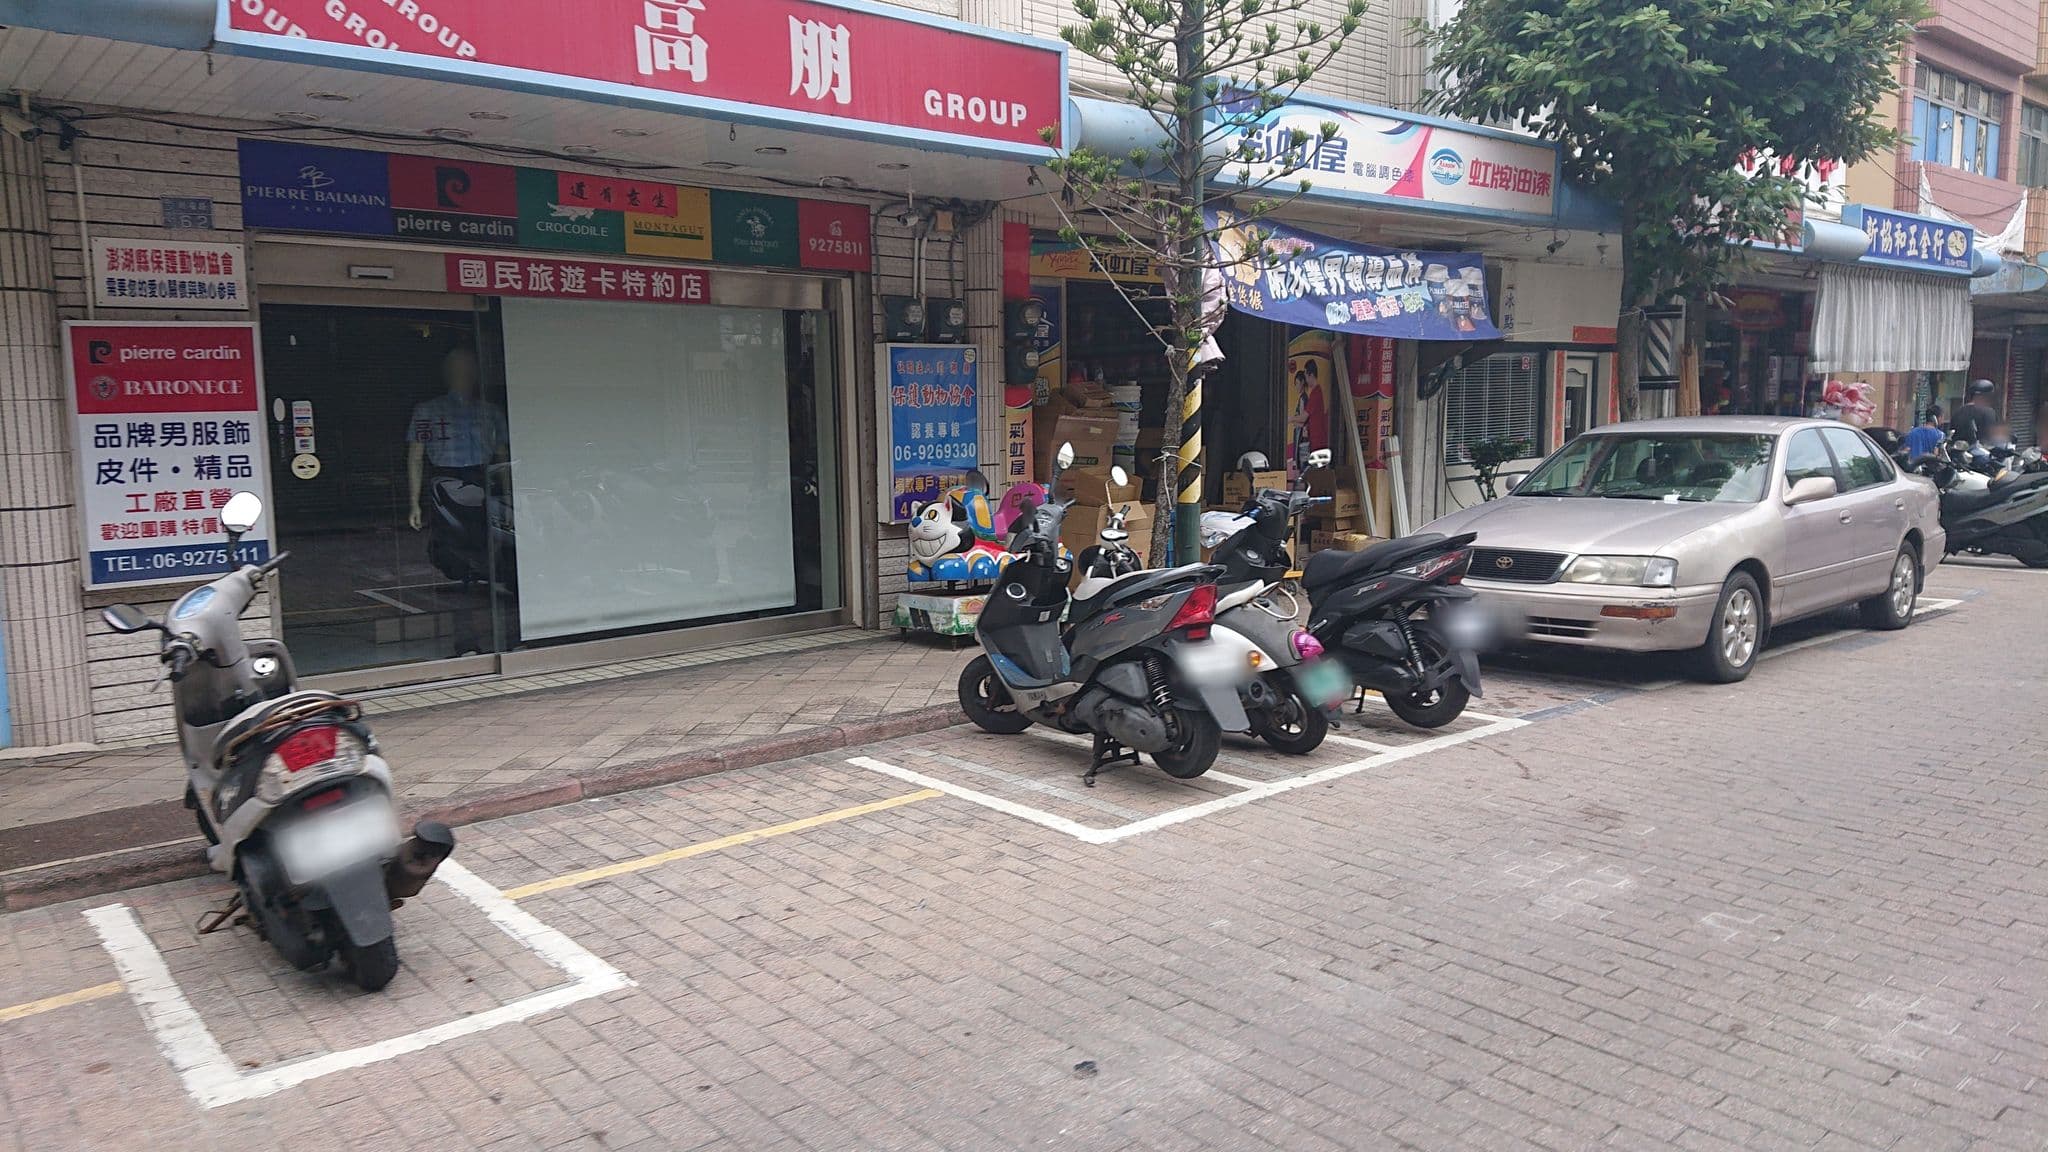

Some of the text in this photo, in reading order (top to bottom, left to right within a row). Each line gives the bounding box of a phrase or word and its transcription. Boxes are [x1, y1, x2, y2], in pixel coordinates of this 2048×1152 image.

[634, 0, 851, 104] 高朋
[924, 89, 1027, 128] GROUP
[1352, 161, 1414, 184] 電腦調色漆
[1468, 157, 1552, 197] 虹牌油漆
[247, 185, 386, 206] PIERRE BALMAIN
[397, 216, 514, 236] pierre cardin
[536, 221, 608, 237] CROCODILE
[633, 220, 705, 236] MONTAGUT
[809, 238, 863, 256] 9275811
[1866, 215, 1945, 261] 新協和五金行
[106, 247, 233, 275] 澎湖縣保護動物協會
[458, 258, 702, 300] 國民旅遊卡特約店
[120, 345, 240, 364] pierre cardin
[124, 379, 243, 397] BARONECE
[892, 382, 976, 408] 保護動物協會
[94, 420, 250, 449] 品牌男服飾
[894, 442, 976, 461] 06-9269330
[1009, 419, 1026, 476] 彩虹屋
[101, 519, 177, 541] 歡迎團購
